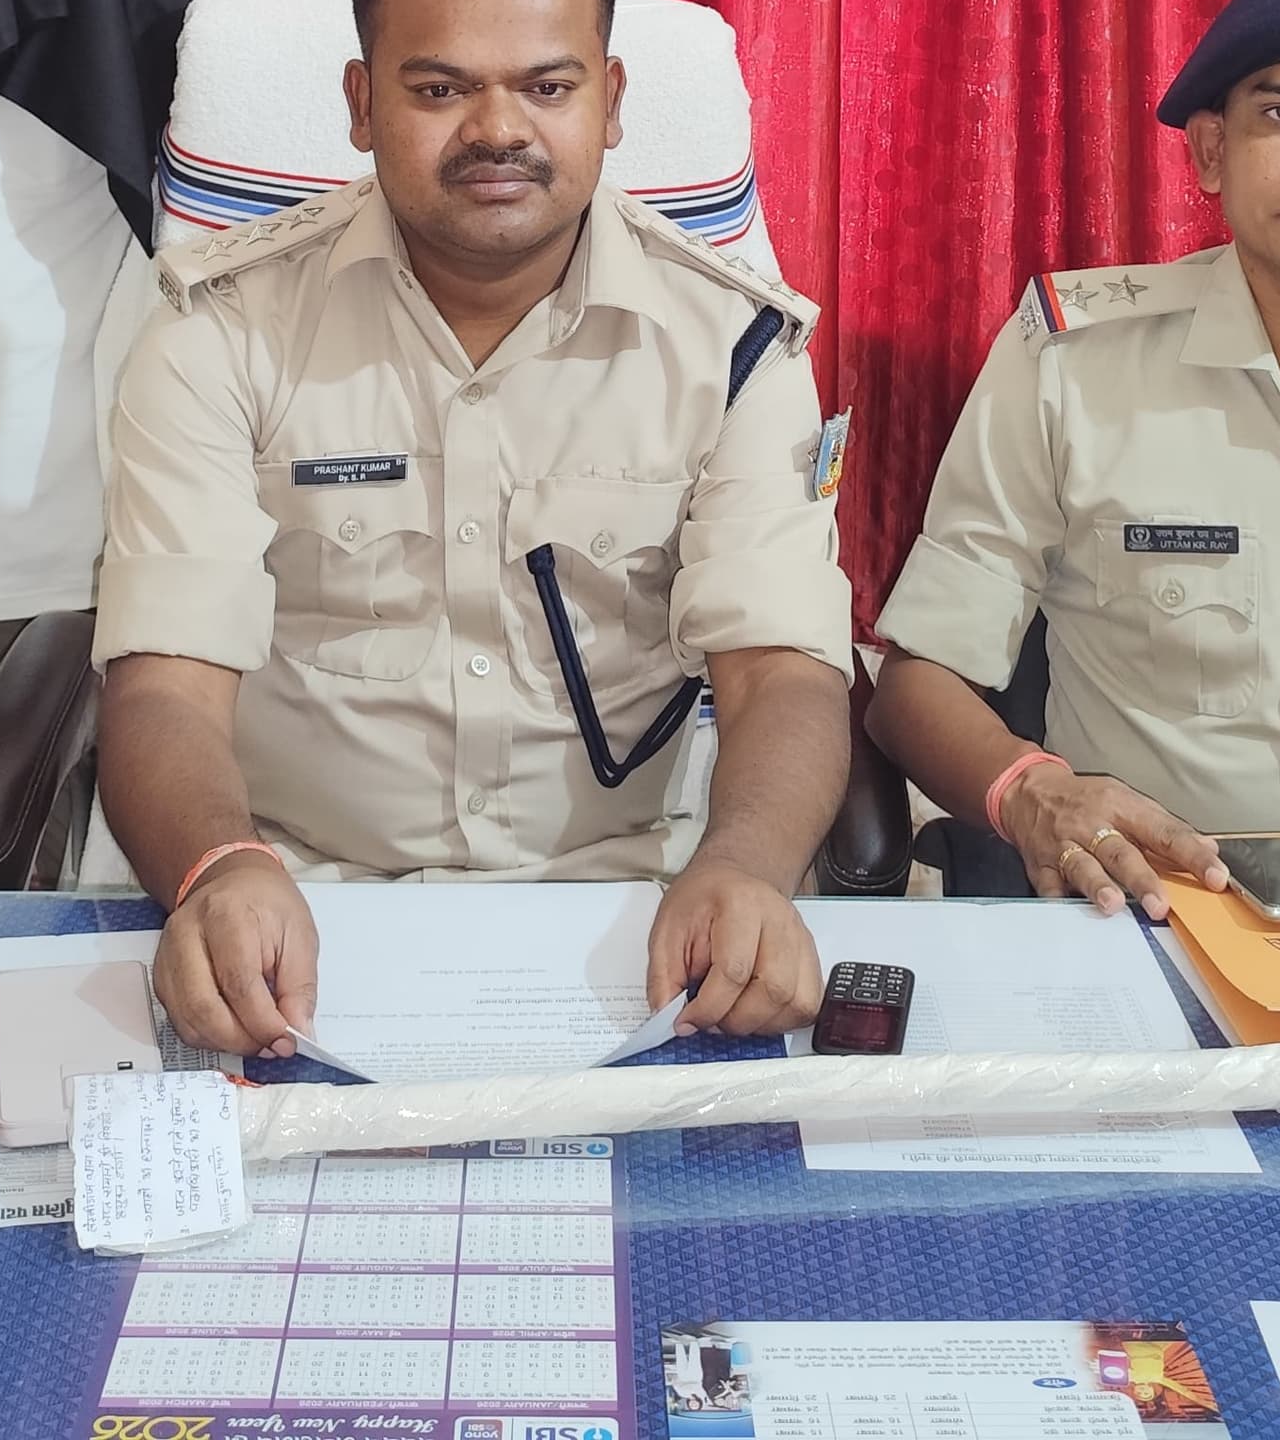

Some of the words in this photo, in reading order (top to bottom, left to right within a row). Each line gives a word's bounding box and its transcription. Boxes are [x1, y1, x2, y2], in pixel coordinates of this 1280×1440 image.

[314, 463, 360, 475] PRASHANT
[361, 461, 391, 472] KUMAR
[1160, 540, 1191, 550] UTTAM
[1209, 542, 1229, 551] RAY
[544, 1143, 583, 1155] SBI
[92, 1416, 215, 1440] 2026
[226, 1414, 286, 1432] Year
[292, 1419, 345, 1431] New
[351, 1415, 438, 1432] Happy
[464, 1430, 498, 1438] yono
[525, 1427, 577, 1440] SBI
